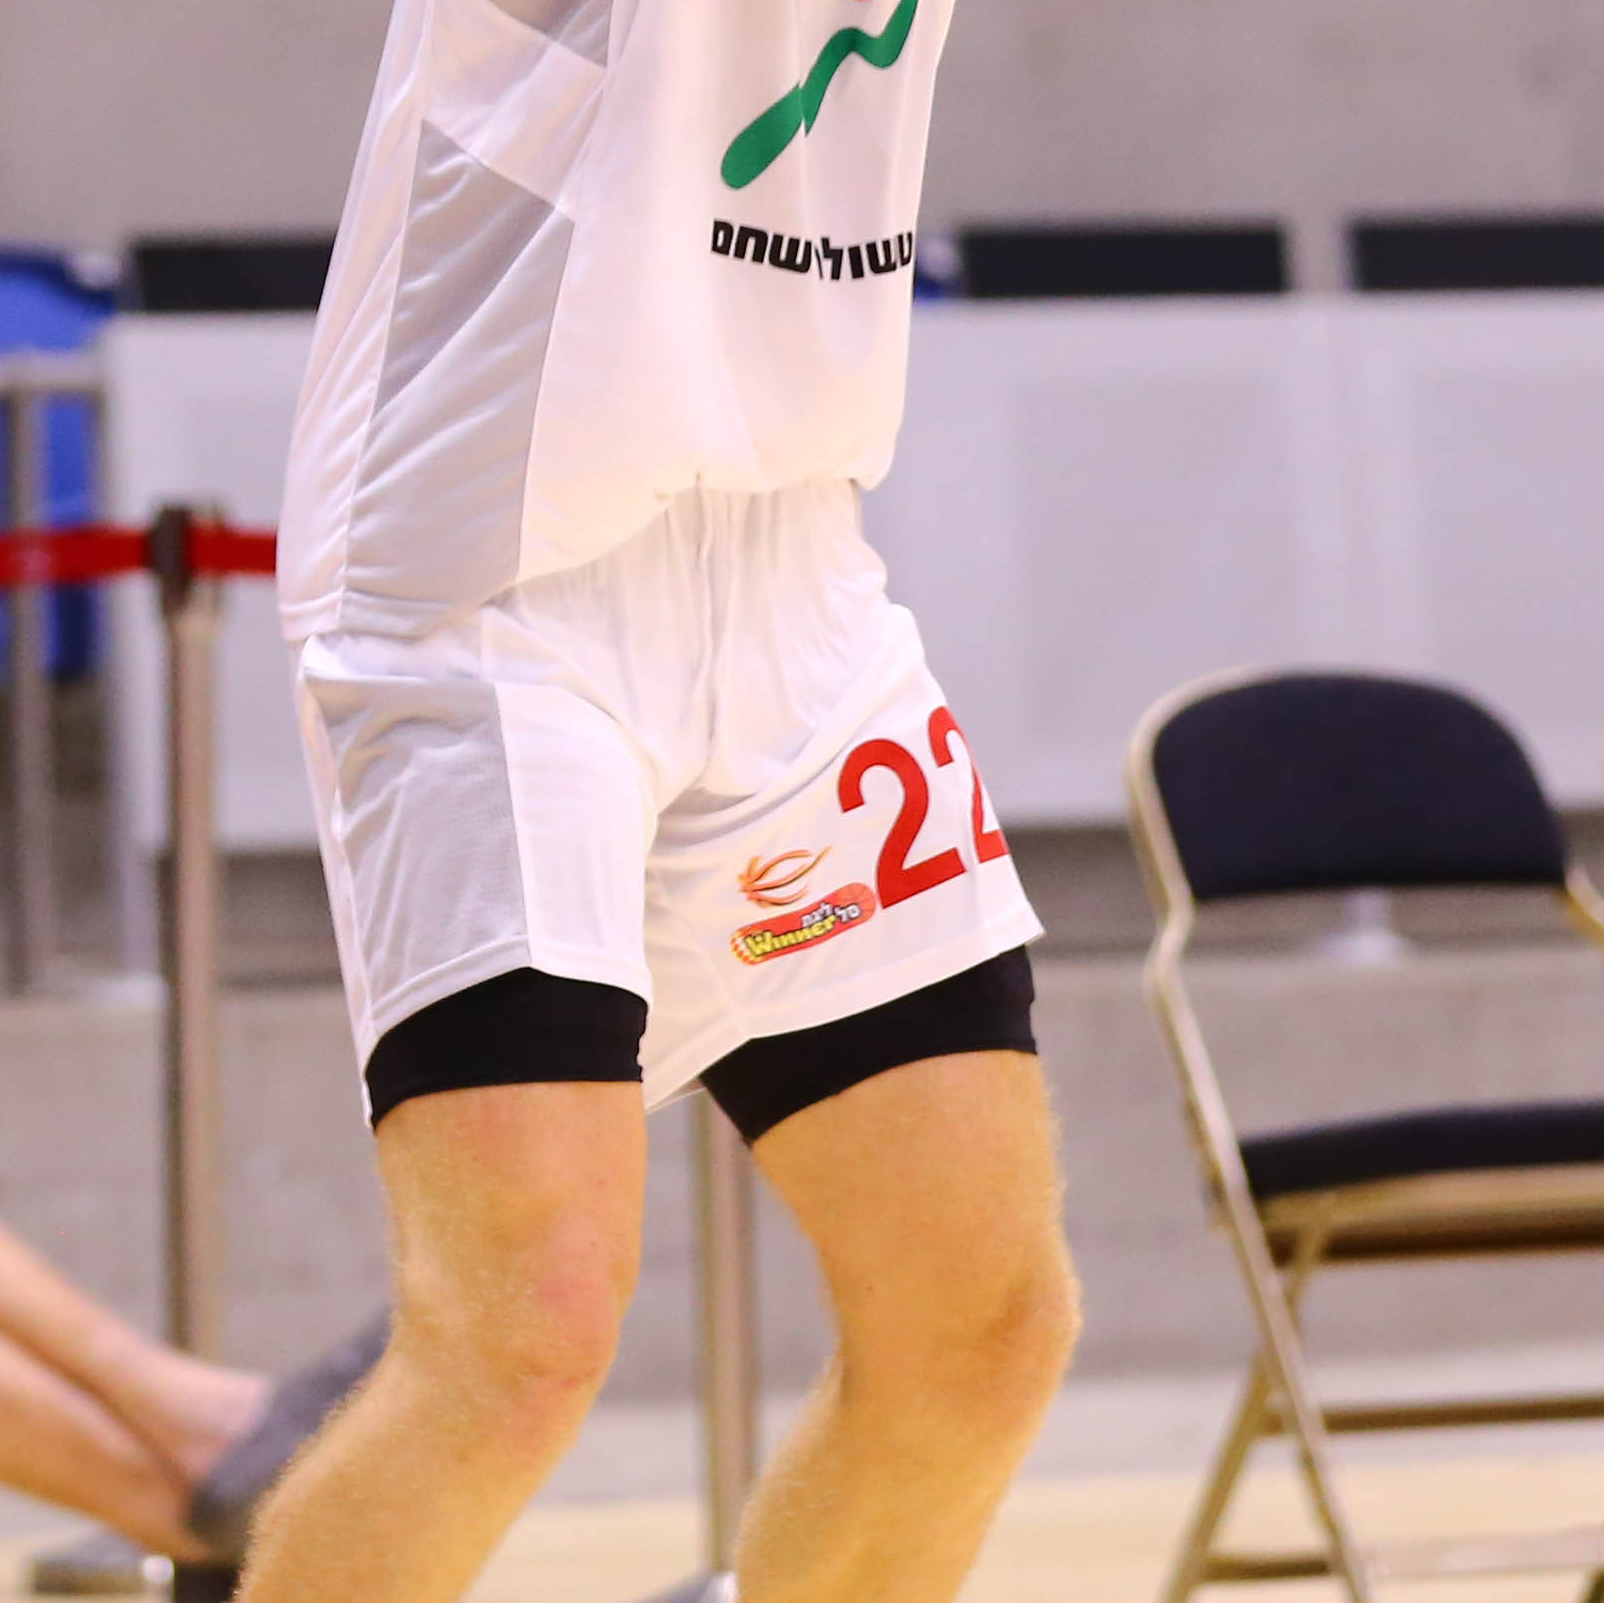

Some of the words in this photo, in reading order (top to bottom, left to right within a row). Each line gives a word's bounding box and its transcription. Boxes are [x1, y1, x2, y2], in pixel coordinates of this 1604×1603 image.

[711, 219, 812, 274] שחם
[838, 706, 1009, 909] 22
[744, 914, 838, 957] Winner
